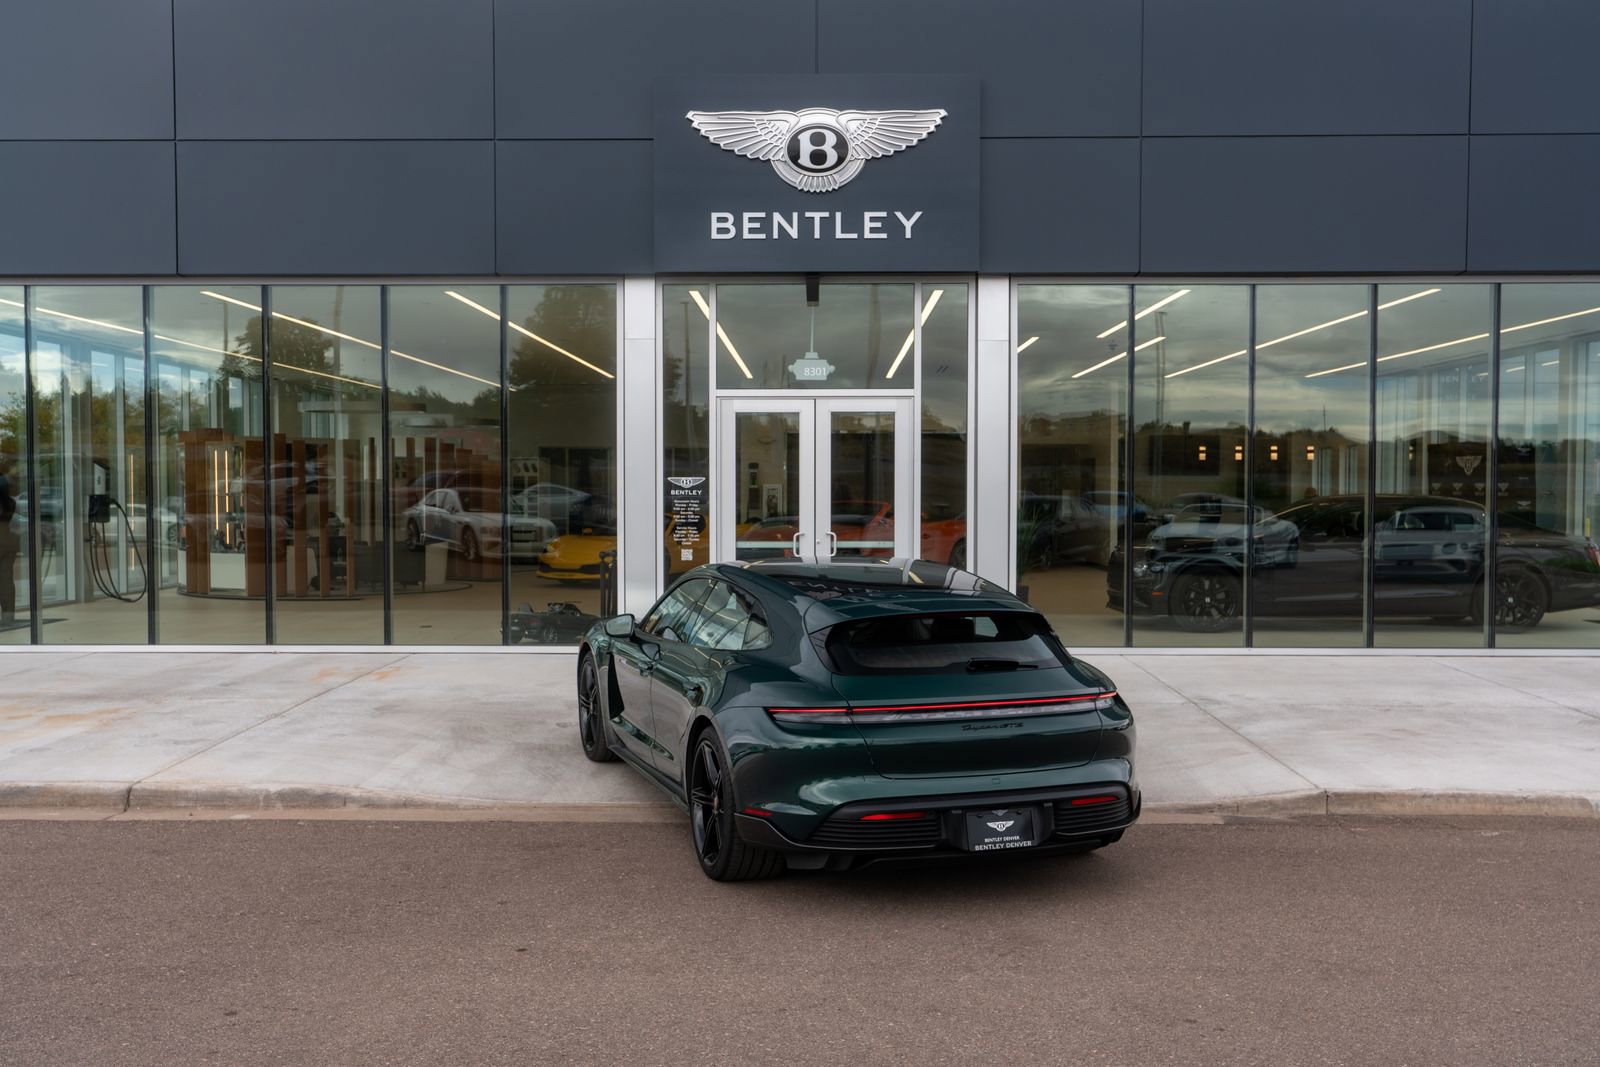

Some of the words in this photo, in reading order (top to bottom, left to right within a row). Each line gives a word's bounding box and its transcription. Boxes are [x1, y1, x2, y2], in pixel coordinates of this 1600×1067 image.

[797, 128, 838, 169] B
[710, 211, 923, 240] BENTLEY
[804, 367, 826, 376] 8301
[974, 843, 1005, 851] BENTLEY
[1005, 840, 1032, 848] DENVER
